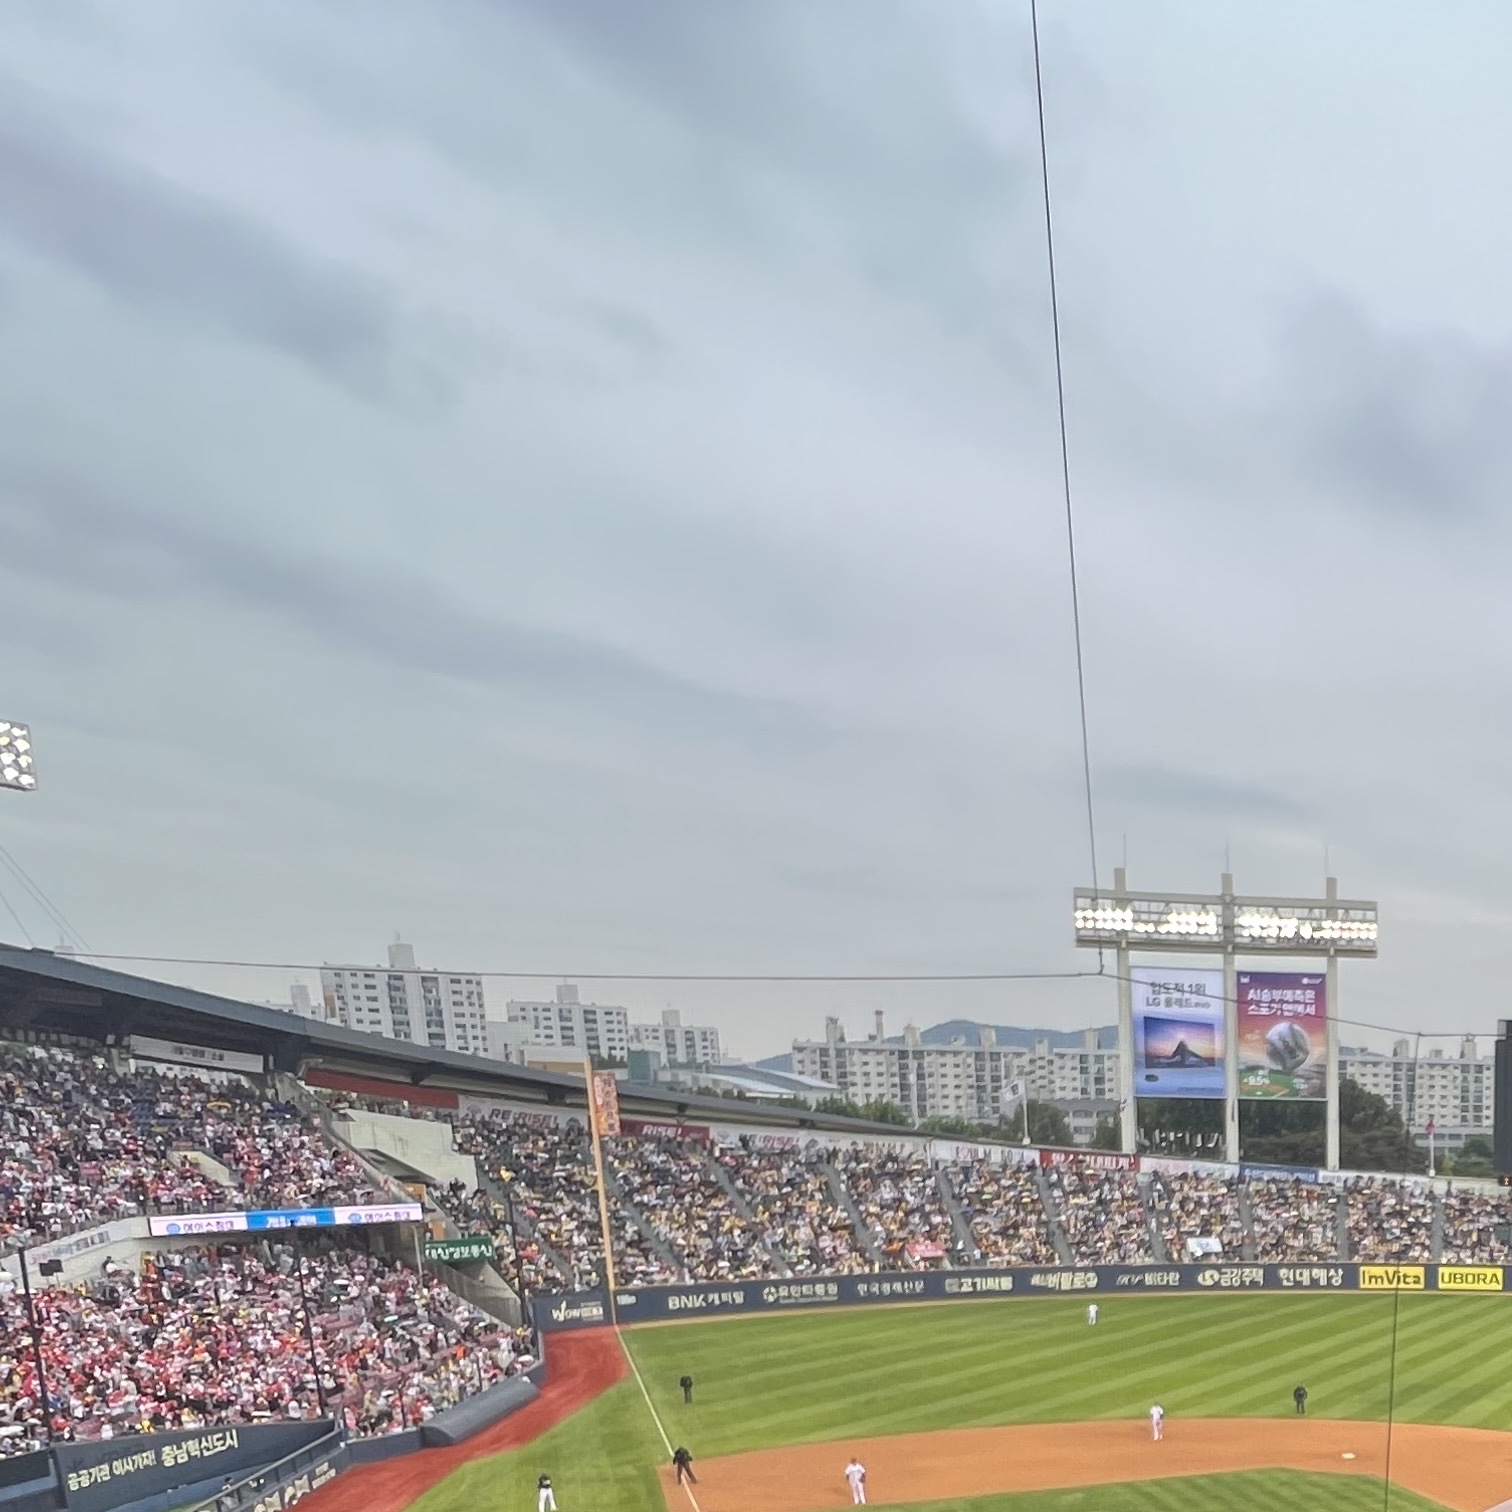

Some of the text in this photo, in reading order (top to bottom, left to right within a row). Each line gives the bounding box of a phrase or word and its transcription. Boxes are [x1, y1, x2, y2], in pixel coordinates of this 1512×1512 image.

[1220, 1267, 1264, 1287] 금강주택
[1278, 1267, 1344, 1287] 현대해상
[1440, 1271, 1501, 1286] UBORA
[161, 1428, 239, 1468] 충남혁신도시
